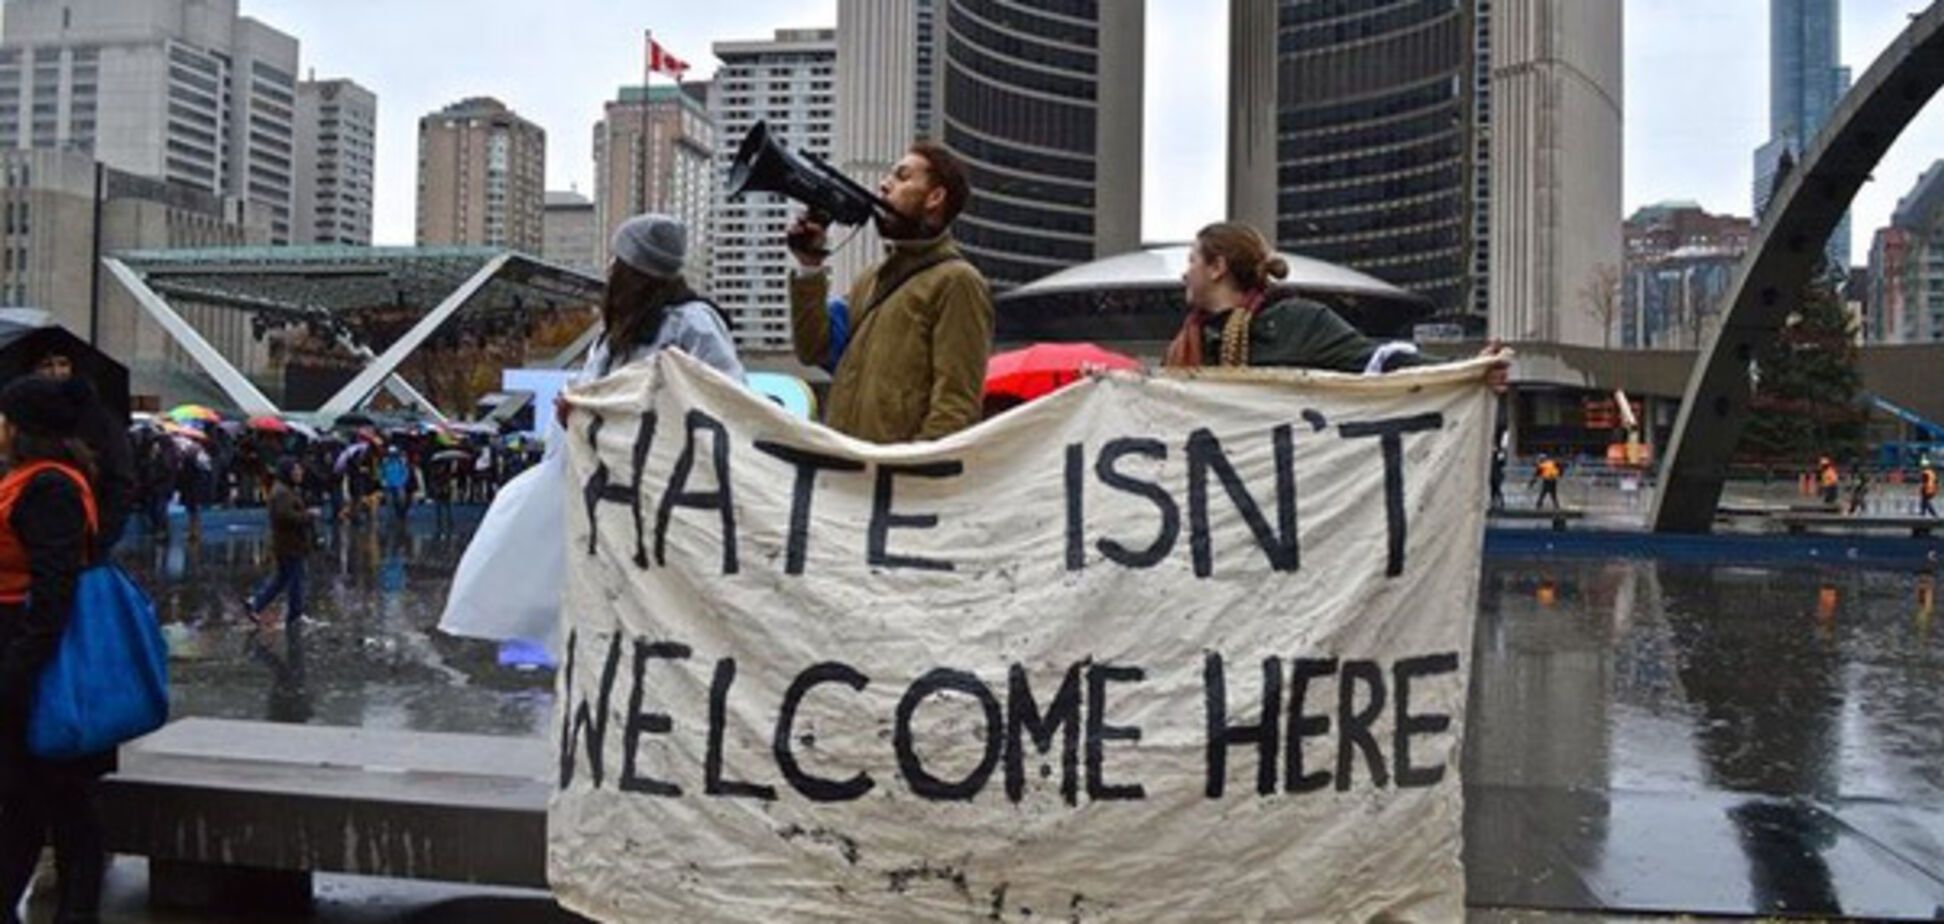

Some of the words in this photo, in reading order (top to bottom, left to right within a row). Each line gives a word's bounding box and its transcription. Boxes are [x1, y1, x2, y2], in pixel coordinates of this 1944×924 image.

[583, 409, 964, 576] HATE
[1064, 409, 1443, 578] ISN'T
[559, 627, 1145, 807] WELCOME
[1203, 651, 1460, 799] HERE
